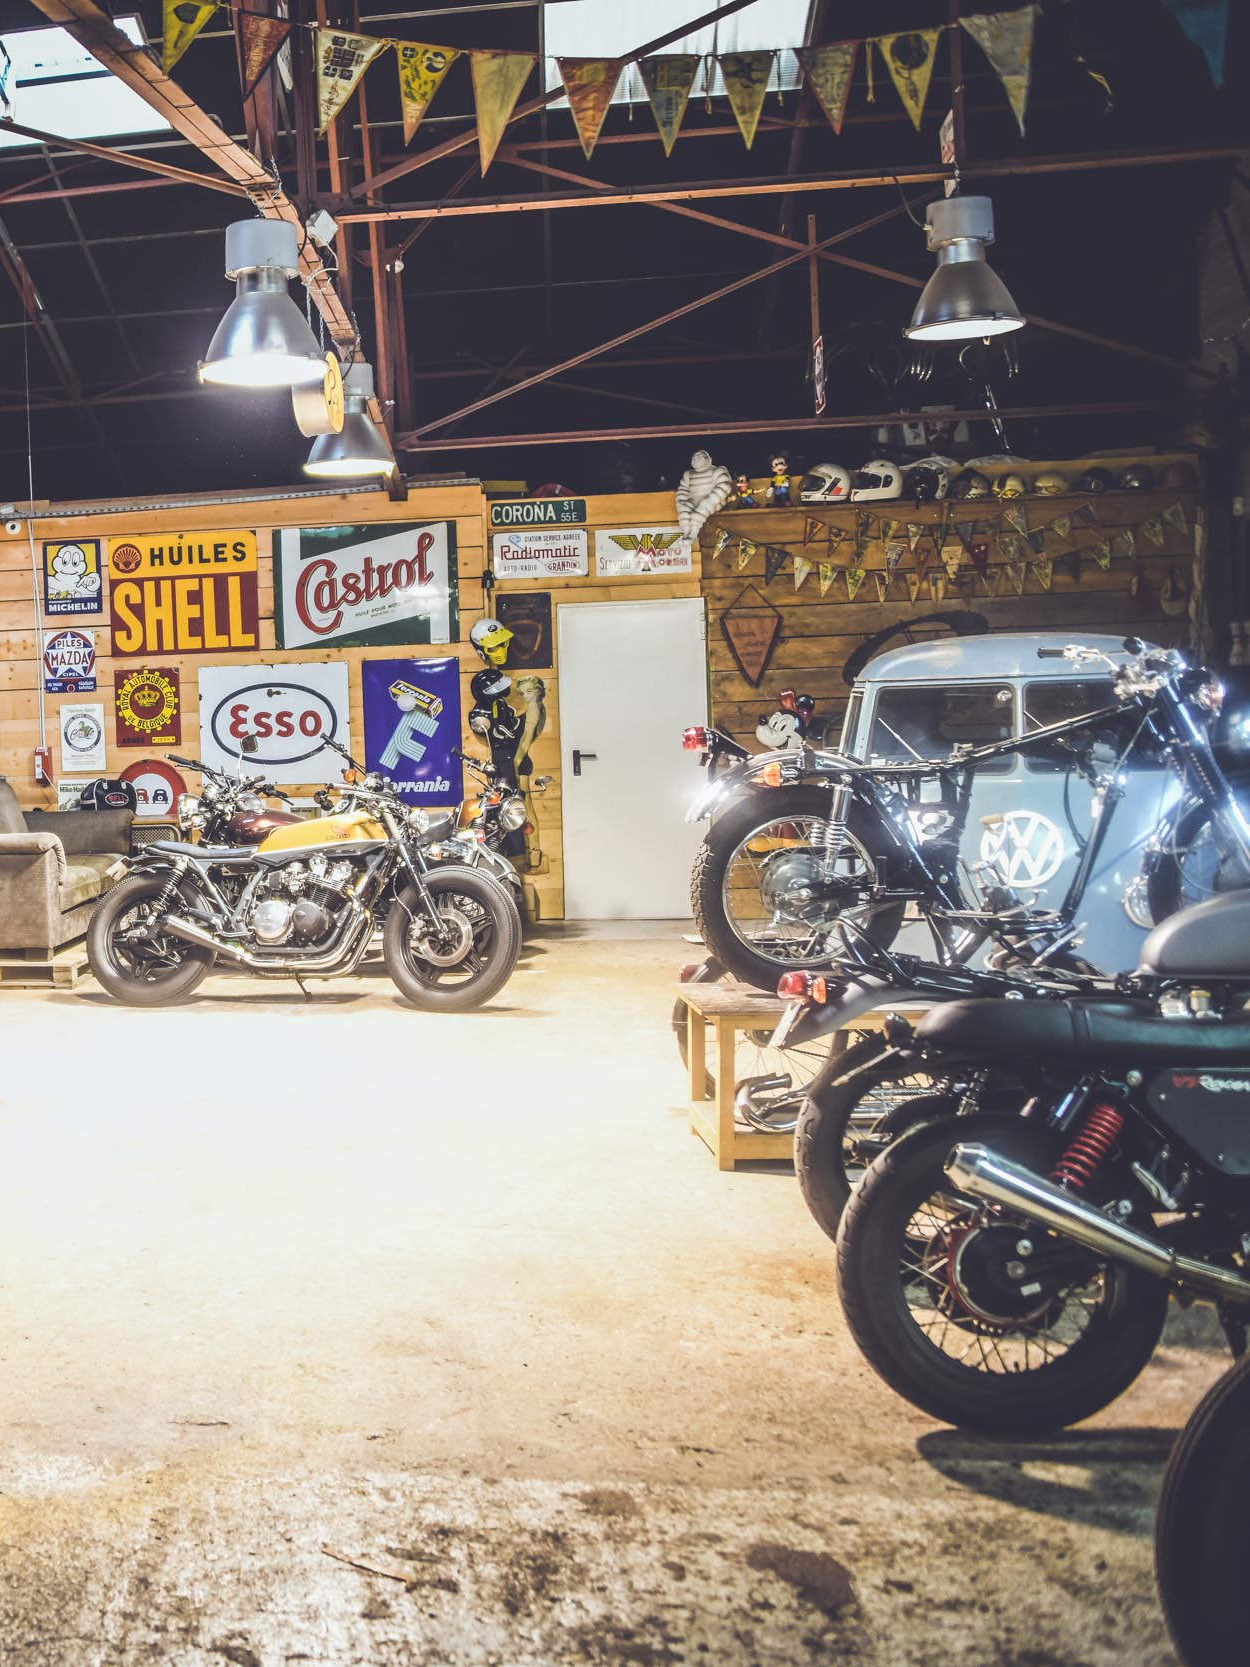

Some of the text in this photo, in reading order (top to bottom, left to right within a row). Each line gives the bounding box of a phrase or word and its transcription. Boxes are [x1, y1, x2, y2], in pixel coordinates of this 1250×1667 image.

[492, 501, 575, 523] CORONA ST
[149, 542, 247, 567] HUILES
[500, 545, 580, 561] Radiomatic
[295, 532, 435, 636] Castrol
[48, 602, 98, 612] MICHELIN
[113, 576, 256, 653] SHELL
[56, 639, 82, 648] PILES
[51, 651, 89, 666] MAZDA
[121, 675, 174, 711] ROYAL AUTOMOBILE CLUB
[127, 713, 168, 729] DE BELGIQUE
